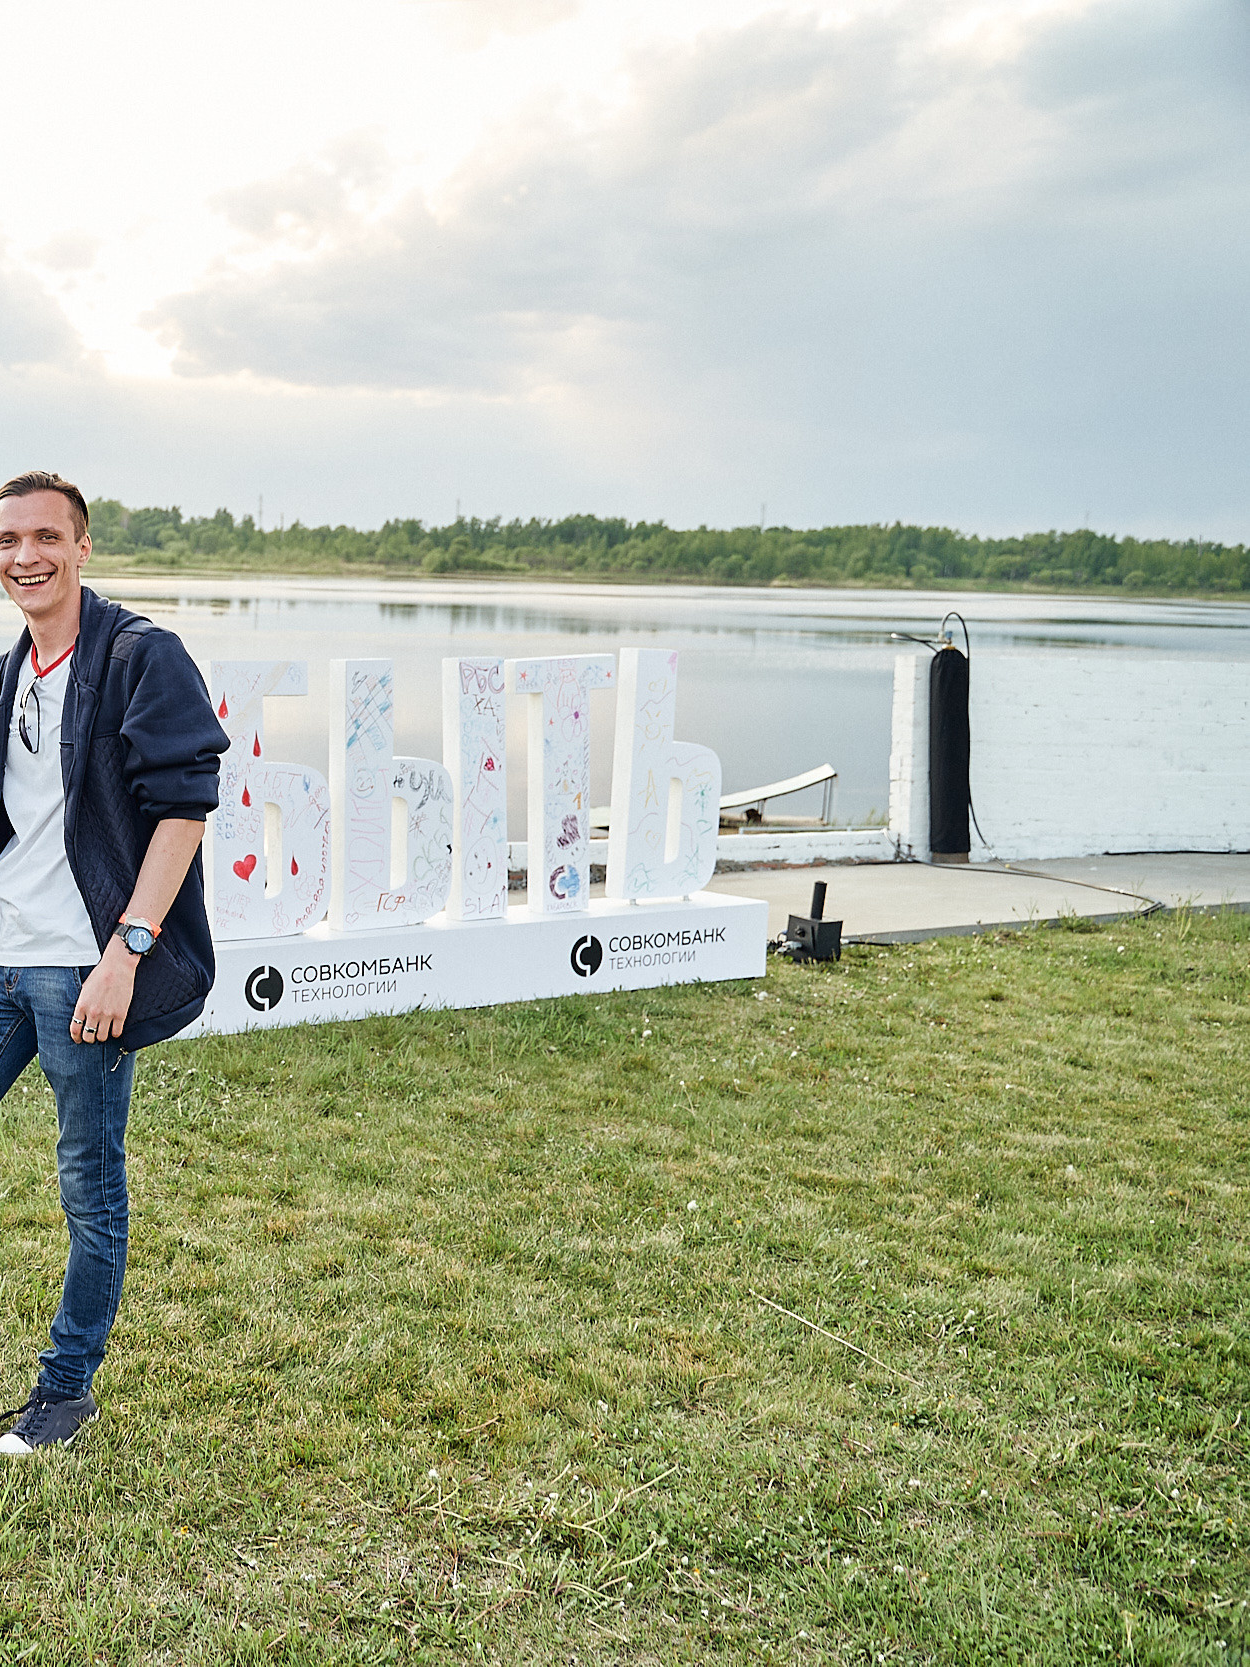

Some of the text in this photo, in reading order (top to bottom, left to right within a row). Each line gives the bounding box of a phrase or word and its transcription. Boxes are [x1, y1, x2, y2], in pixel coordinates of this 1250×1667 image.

[459, 662, 505, 695] РБС
[609, 927, 726, 953] СОВКОМБАНК
[291, 953, 433, 984] СОВКОМБАНК
[609, 951, 696, 970] ТЕХНОЛОГИИ
[291, 980, 397, 1003] ТЕХНОЛОГИИ
